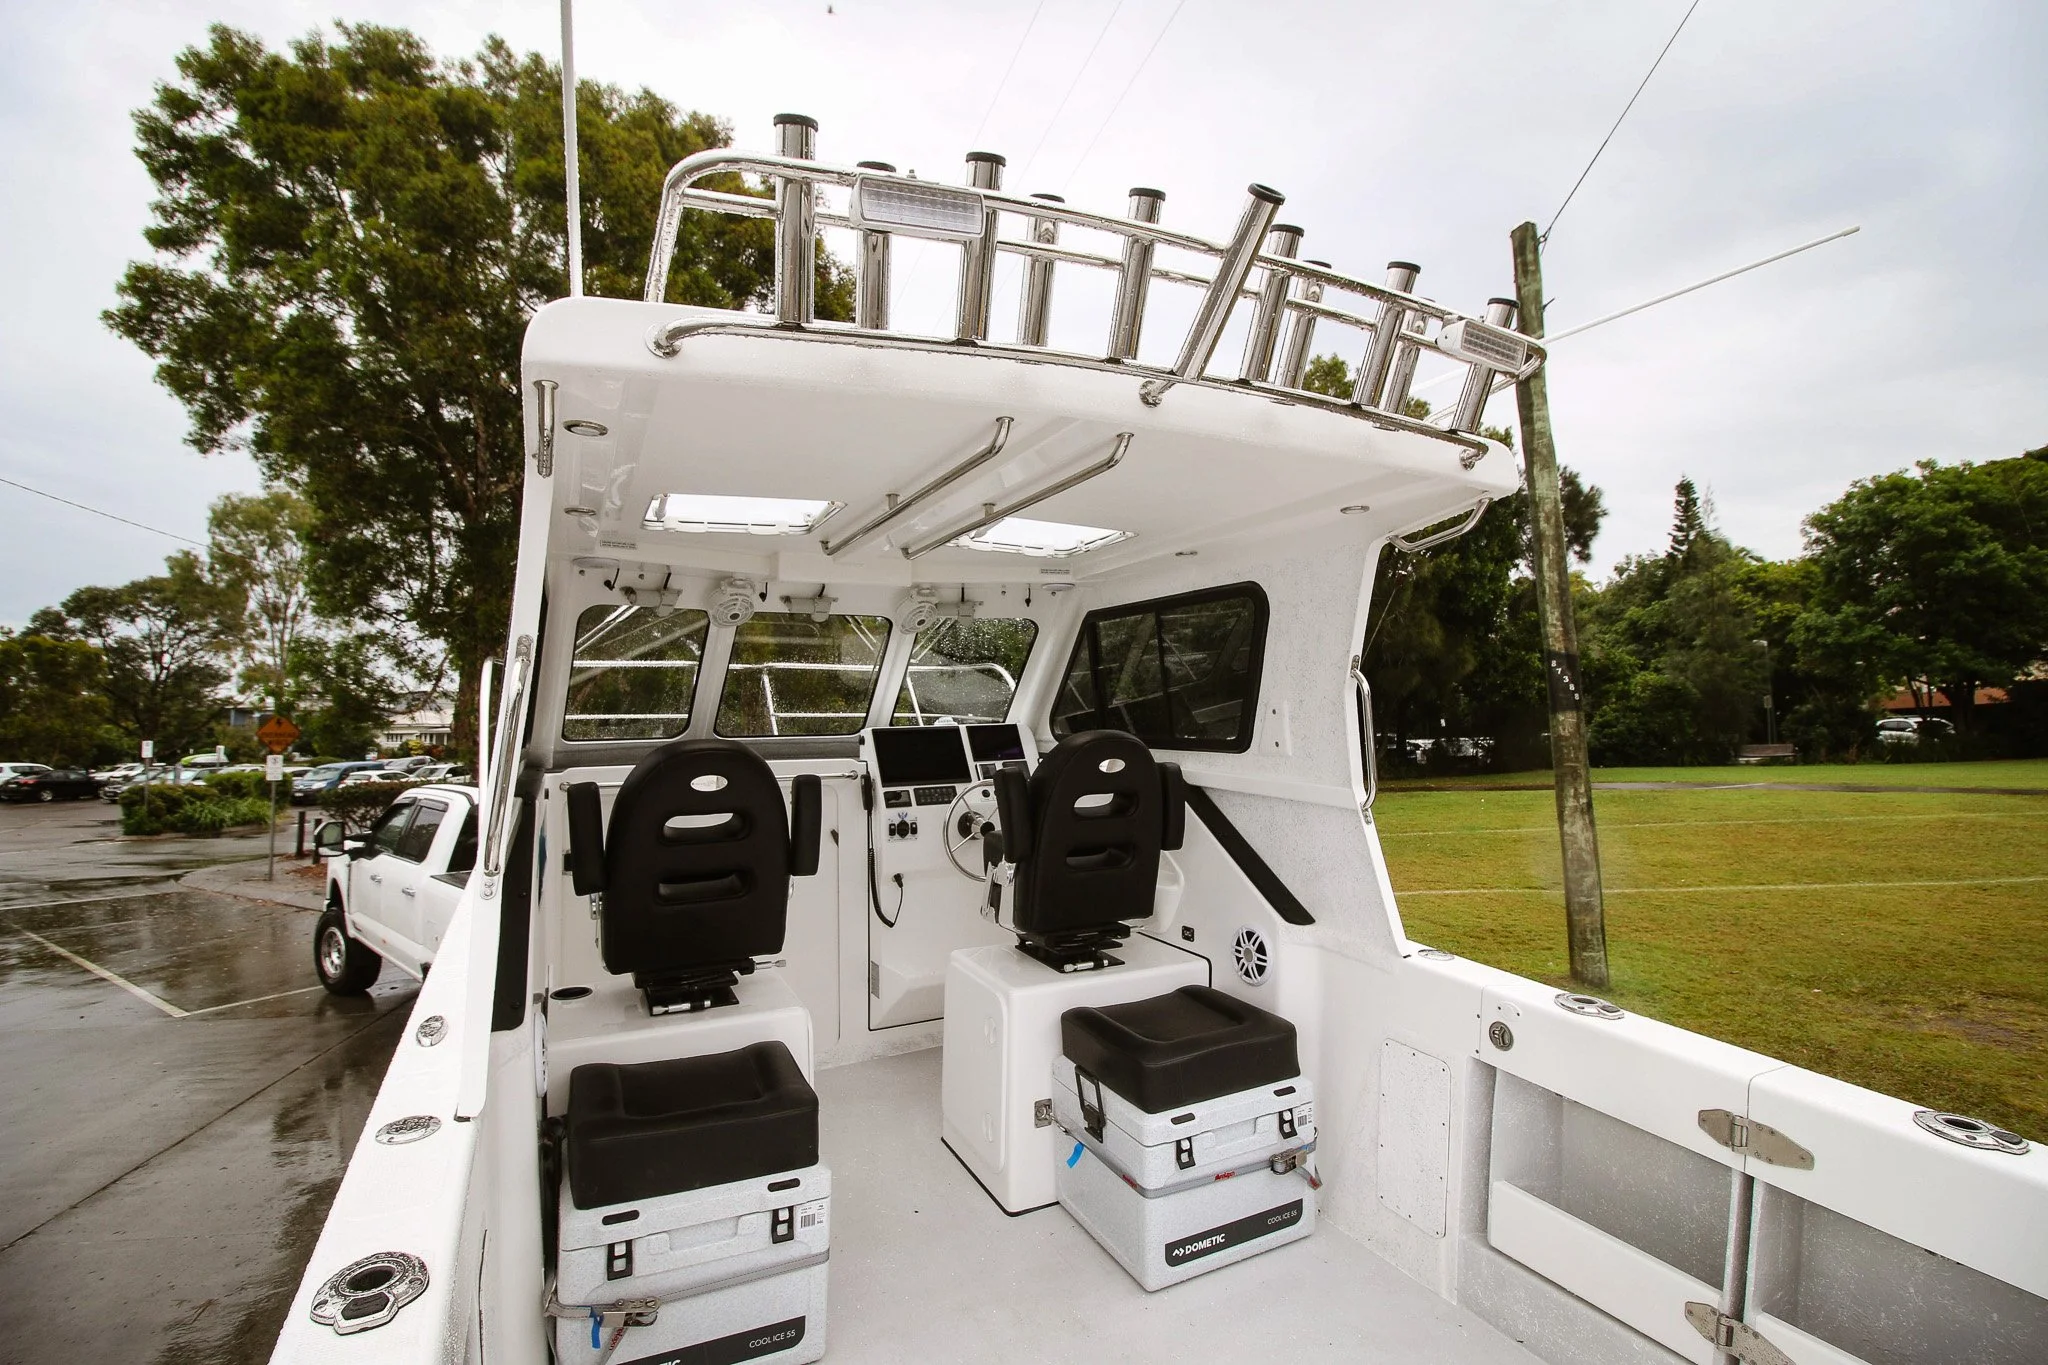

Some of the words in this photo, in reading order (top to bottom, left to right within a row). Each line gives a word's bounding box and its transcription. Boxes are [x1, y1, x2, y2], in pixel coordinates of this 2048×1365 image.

[1551, 660, 1580, 700] 87388
[1267, 1215, 1282, 1225] COOL
[1282, 1211, 1291, 1220] ICE
[1185, 1233, 1226, 1255] DOMETIC
[749, 1336, 772, 1348] COOL
[772, 1332, 785, 1342] ICE
[786, 1329, 796, 1339] 55
